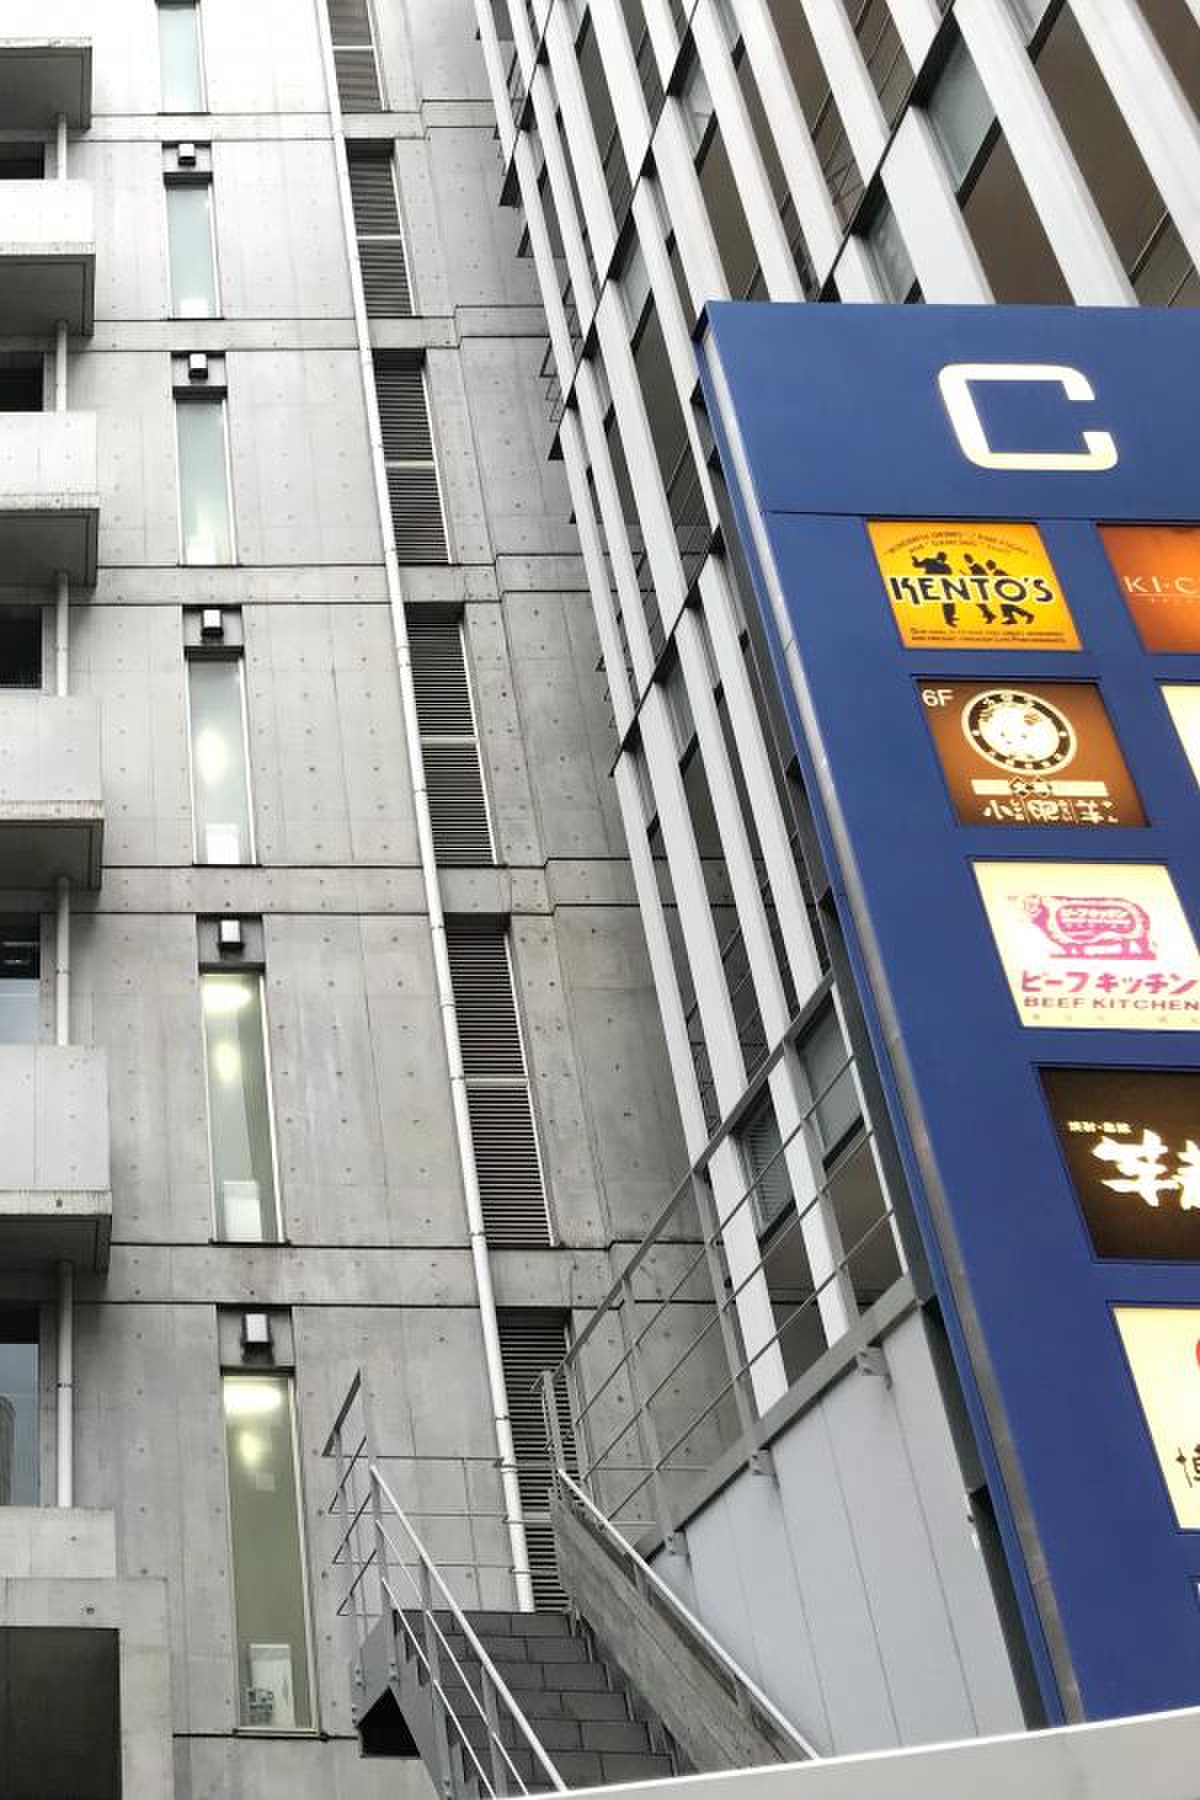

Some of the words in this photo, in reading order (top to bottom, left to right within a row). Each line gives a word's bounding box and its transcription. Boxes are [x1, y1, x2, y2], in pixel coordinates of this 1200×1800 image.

[889, 576, 1054, 605] KENTO'S
[921, 688, 953, 706] 6F
[1024, 997, 1086, 1008] BEEF
[1092, 998, 1200, 1011] KITCHEN
